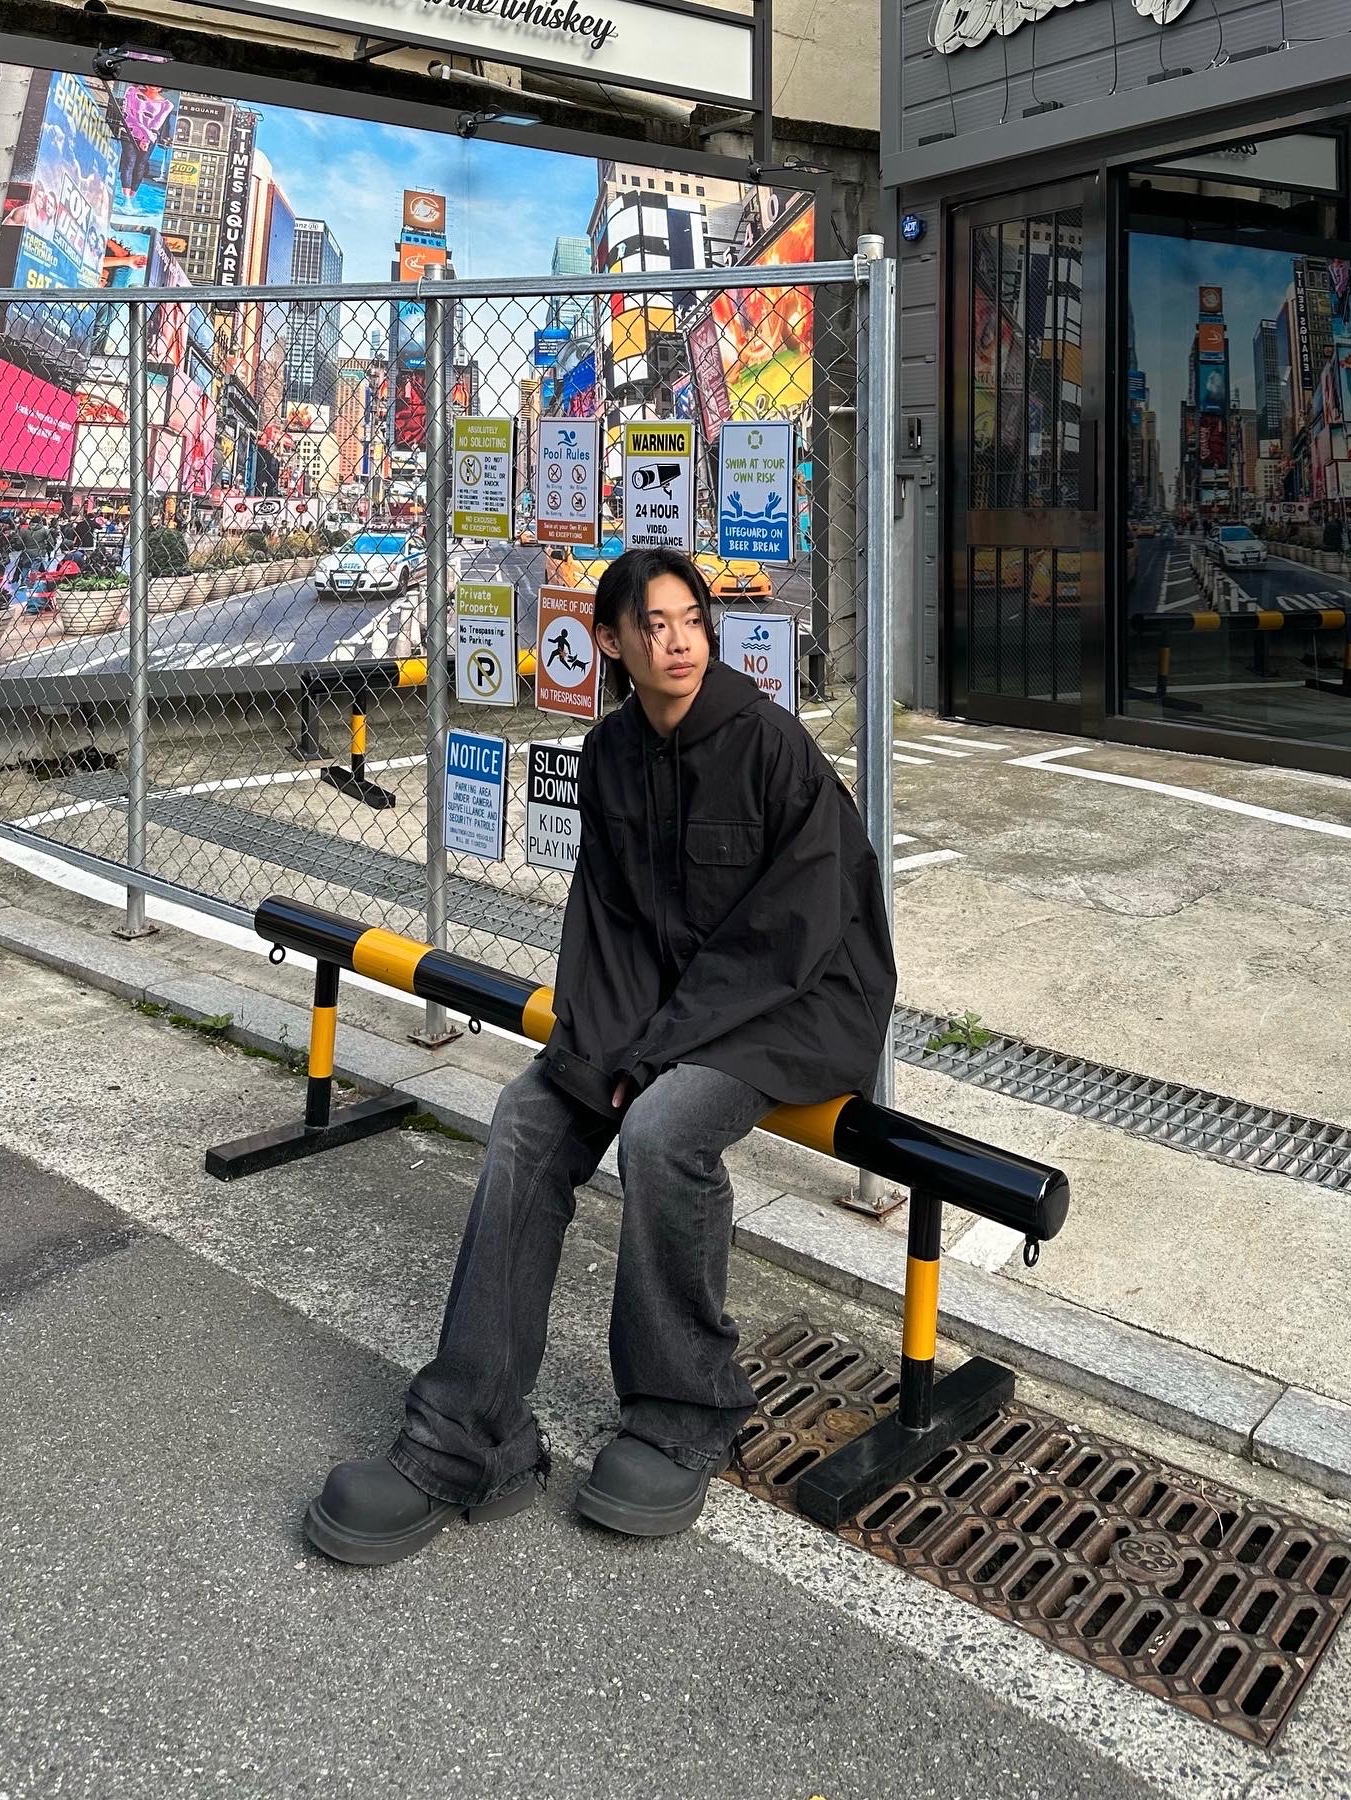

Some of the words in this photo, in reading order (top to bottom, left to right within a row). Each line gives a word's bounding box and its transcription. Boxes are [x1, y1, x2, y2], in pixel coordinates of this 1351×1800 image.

[500, 0, 615, 49] whiskey
[232, 128, 251, 193] TIMES
[60, 174, 90, 233] FOX
[221, 201, 243, 286] SQUARE
[467, 425, 499, 434] ABSOLUTELY
[459, 437, 468, 447] NO
[470, 438, 507, 448] SOLICITING
[632, 433, 685, 452] WARNING
[543, 447, 562, 460] Pool
[566, 448, 590, 460] Rules
[725, 458, 747, 470] SWIM
[749, 458, 758, 470] AT
[762, 458, 785, 470] YOUR
[733, 472, 753, 483] OWN
[757, 473, 776, 484] RISK
[635, 503, 648, 518] 24
[650, 504, 679, 519] HOUR
[465, 515, 473, 523] NO
[474, 516, 497, 524] EXCUSES
[469, 525, 502, 533] EXCEPTIONS
[646, 524, 668, 534] VIDEO
[725, 526, 768, 538] LIFEGUARD
[770, 528, 783, 538] ON
[632, 535, 683, 547] SURVEILLANCE
[729, 540, 750, 551] BEER
[752, 541, 780, 553] BREAK
[459, 588, 491, 600] Private
[459, 601, 499, 616] Property
[542, 597, 567, 612] BEWARE
[568, 601, 578, 613] OF
[579, 602, 594, 615] DOG
[459, 625, 467, 633] No
[469, 625, 506, 637] Trespassing.
[459, 636, 467, 644] No
[468, 637, 493, 647] Parking.
[743, 654, 768, 674] NO
[540, 688, 549, 699] NO
[550, 689, 592, 708] TRESPASSING
[449, 742, 500, 775] NOTICE
[534, 750, 579, 779] SLOW
[455, 782, 476, 794] PARKING
[479, 787, 491, 797] AREA
[533, 775, 579, 805] DOWN
[453, 791, 470, 803] UNDER
[472, 796, 493, 809] CAMERA
[447, 801, 485, 818] SURVEILLANCE
[487, 811, 498, 821] AND
[449, 812, 472, 826] SECURITY
[474, 818, 496, 832] PATROLS
[539, 813, 572, 836] KIDS
